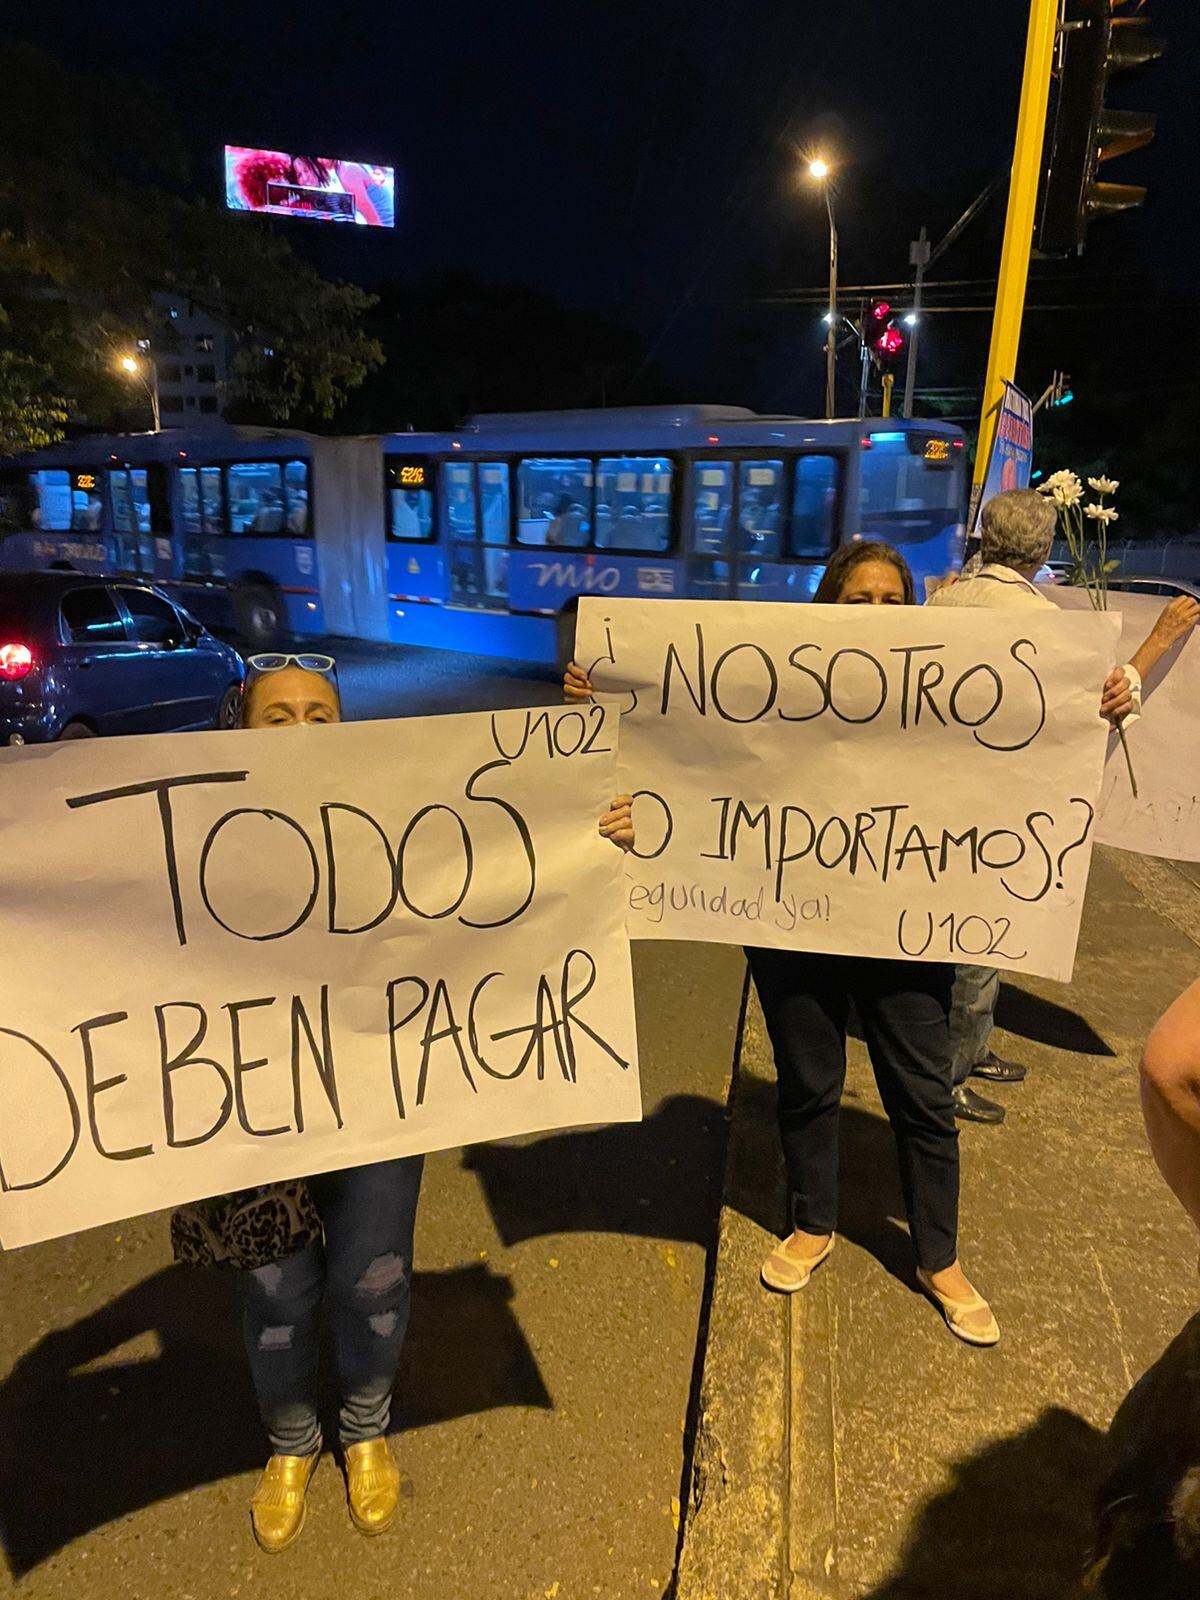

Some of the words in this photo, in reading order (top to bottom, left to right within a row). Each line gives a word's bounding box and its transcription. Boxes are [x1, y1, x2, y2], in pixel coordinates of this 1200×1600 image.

[491, 704, 612, 759] U102
[660, 623, 1046, 752] NOSOTROS
[66, 760, 536, 946] TODOS
[625, 874, 764, 923] eguridad
[774, 892, 831, 931] ya!
[700, 797, 1094, 904] IMPORTAMOS?
[897, 908, 1028, 960] U102
[0, 985, 344, 1192] DEBEN
[386, 949, 630, 1119] PAGAR
